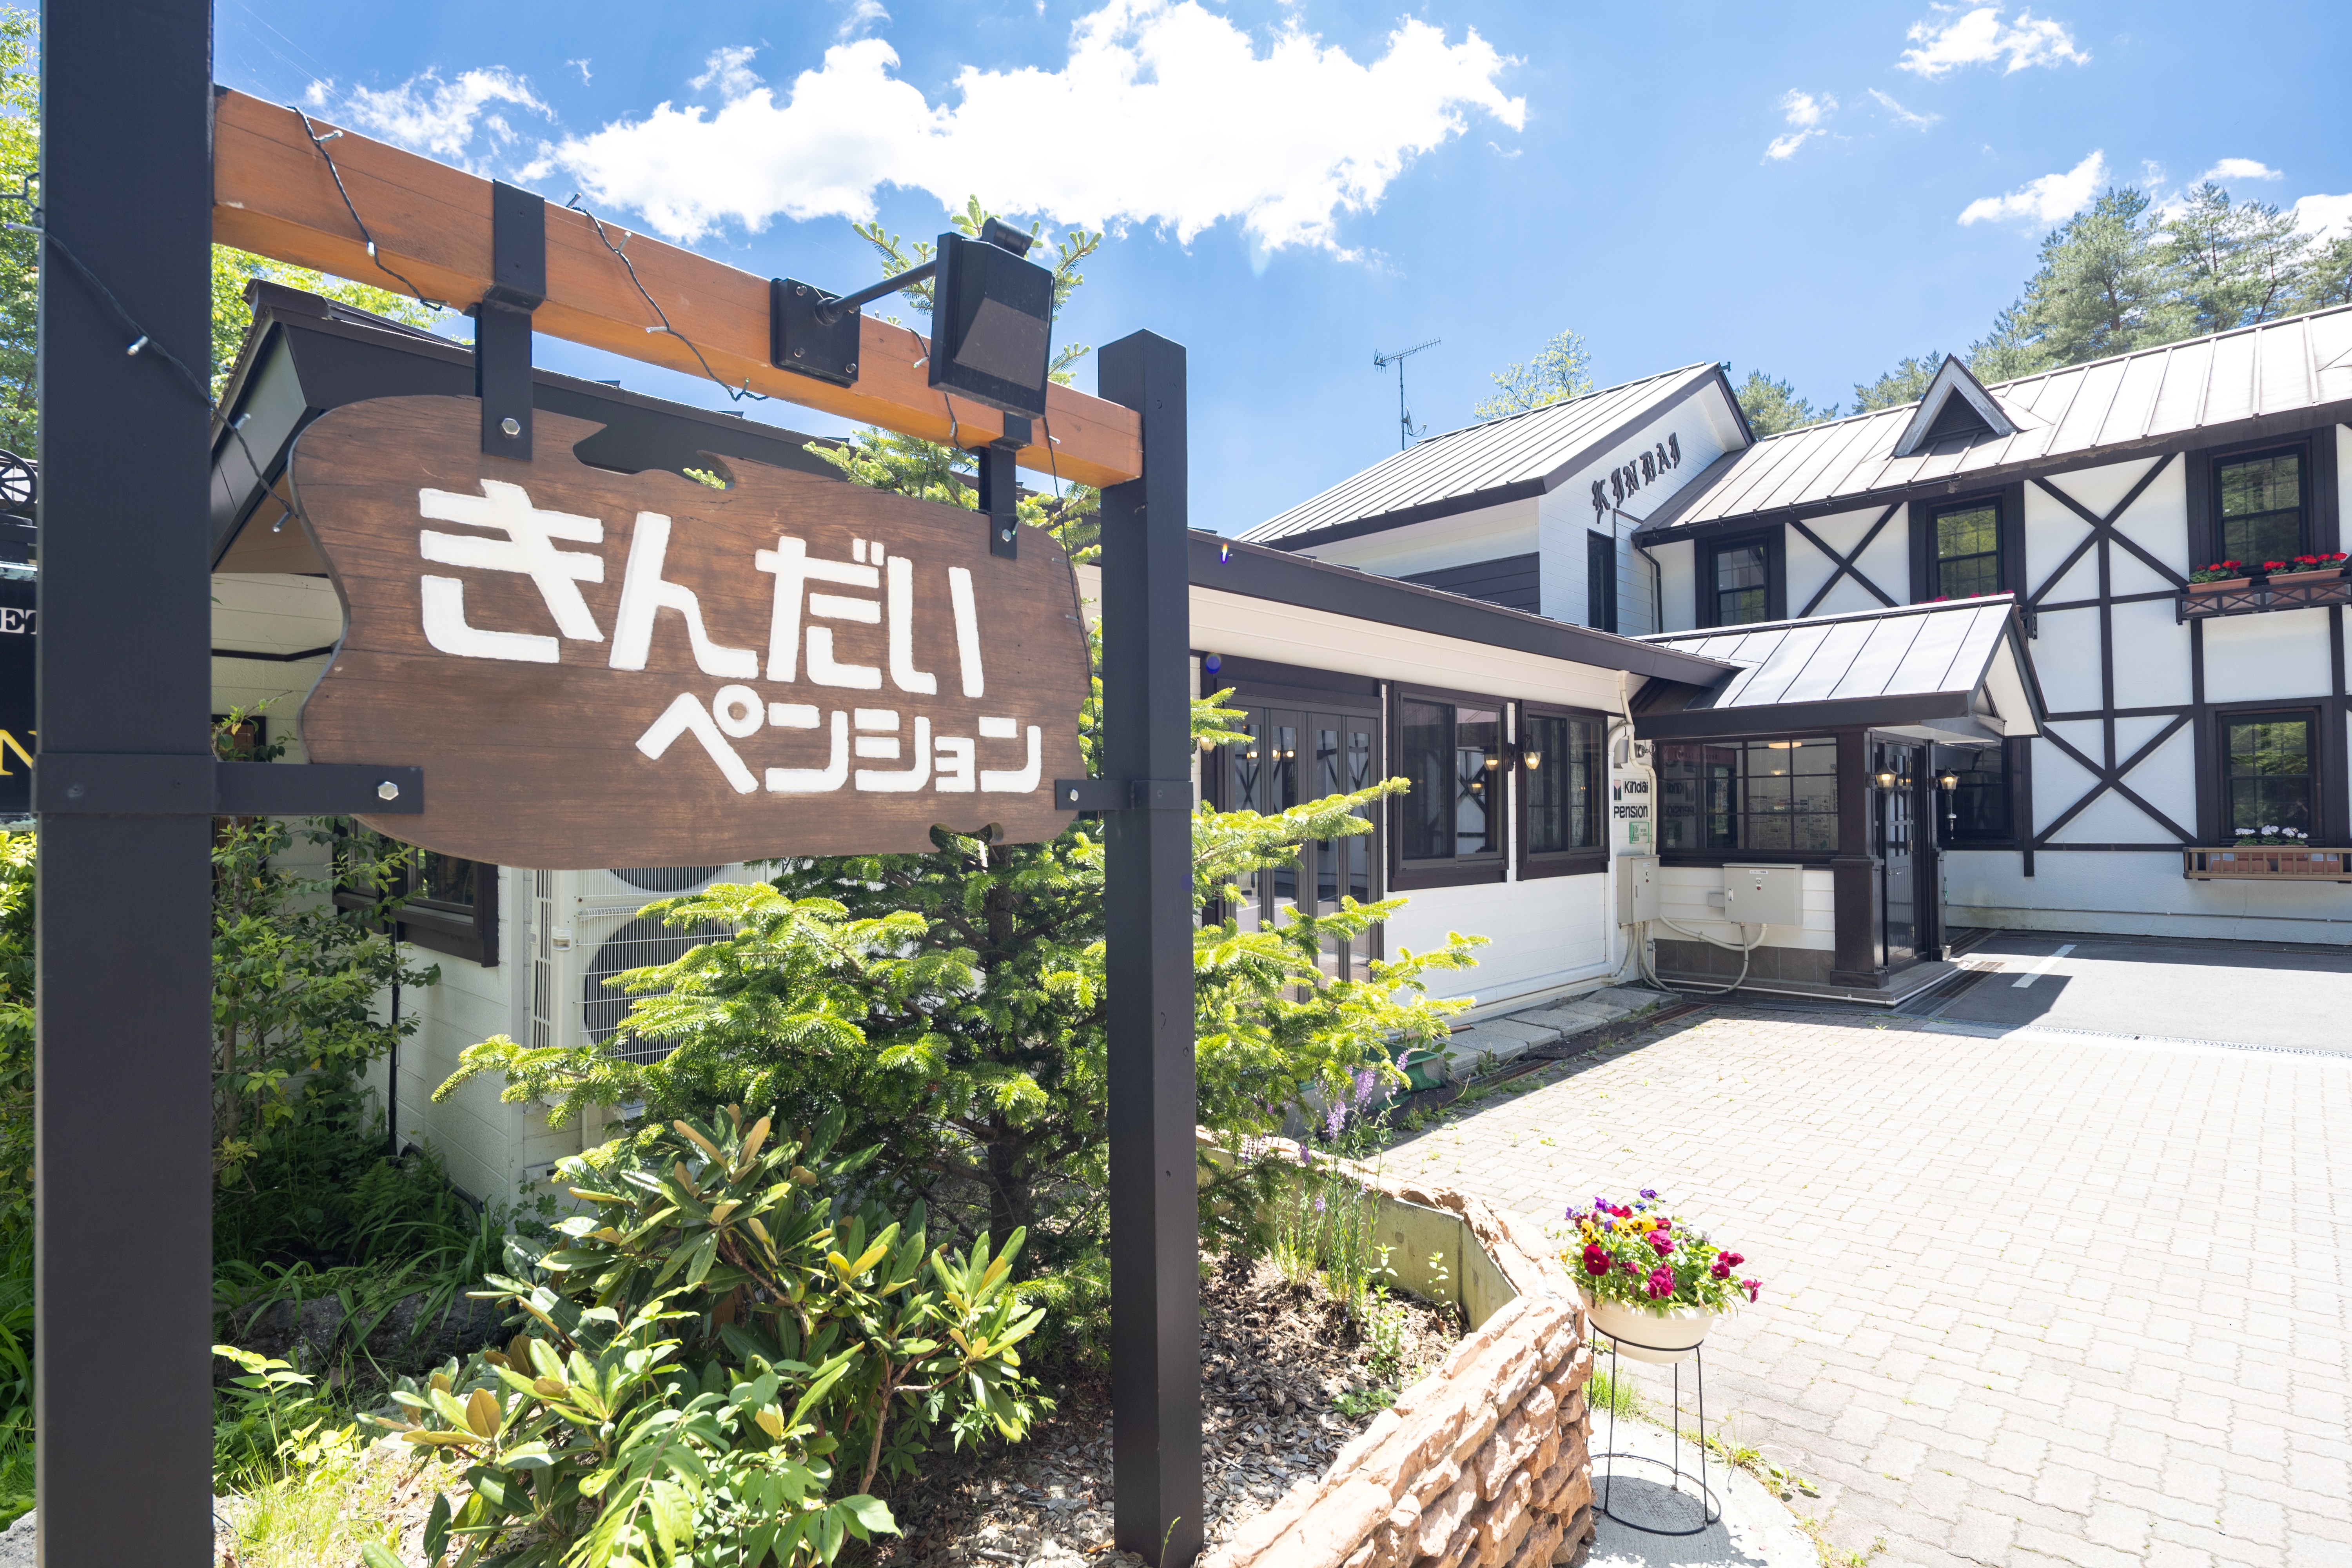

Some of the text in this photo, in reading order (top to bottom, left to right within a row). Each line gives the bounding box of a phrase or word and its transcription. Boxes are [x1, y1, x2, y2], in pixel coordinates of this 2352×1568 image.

[419, 479, 983, 698] きんだい
[636, 684, 1042, 793] ペンション
[1614, 806, 1648, 818] Pension
[1624, 781, 1648, 793] Kindai
